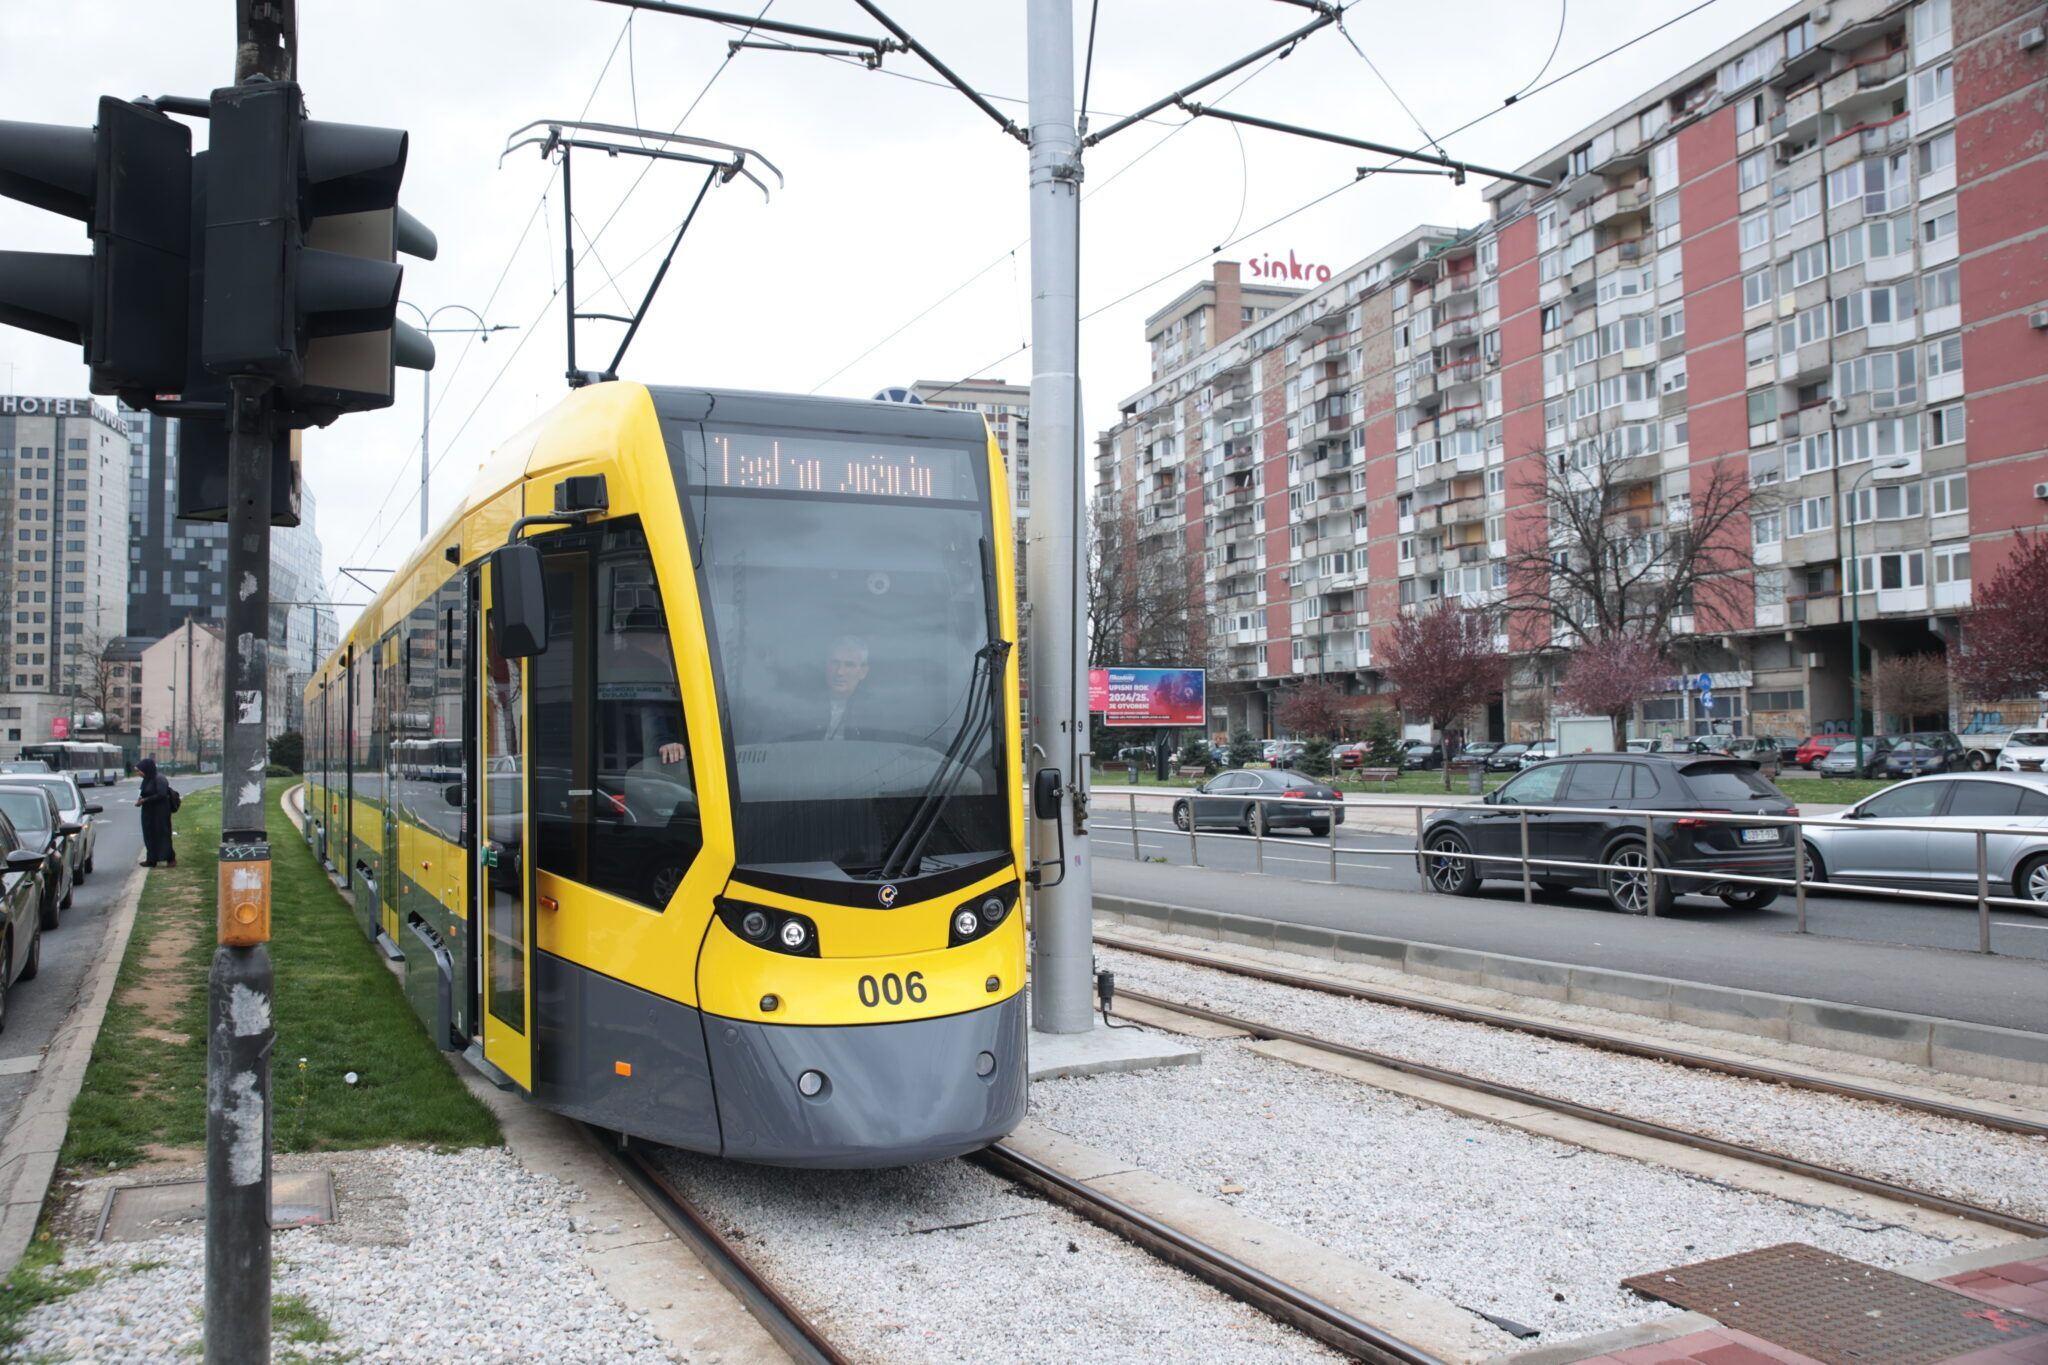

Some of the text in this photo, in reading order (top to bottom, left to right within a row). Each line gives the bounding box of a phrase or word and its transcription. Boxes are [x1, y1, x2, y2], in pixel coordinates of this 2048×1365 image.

[1249, 248, 1331, 282] sinkro
[3, 396, 79, 414] HOTEL
[1109, 692, 1150, 702] 2024/25.
[858, 970, 927, 1007] 006
